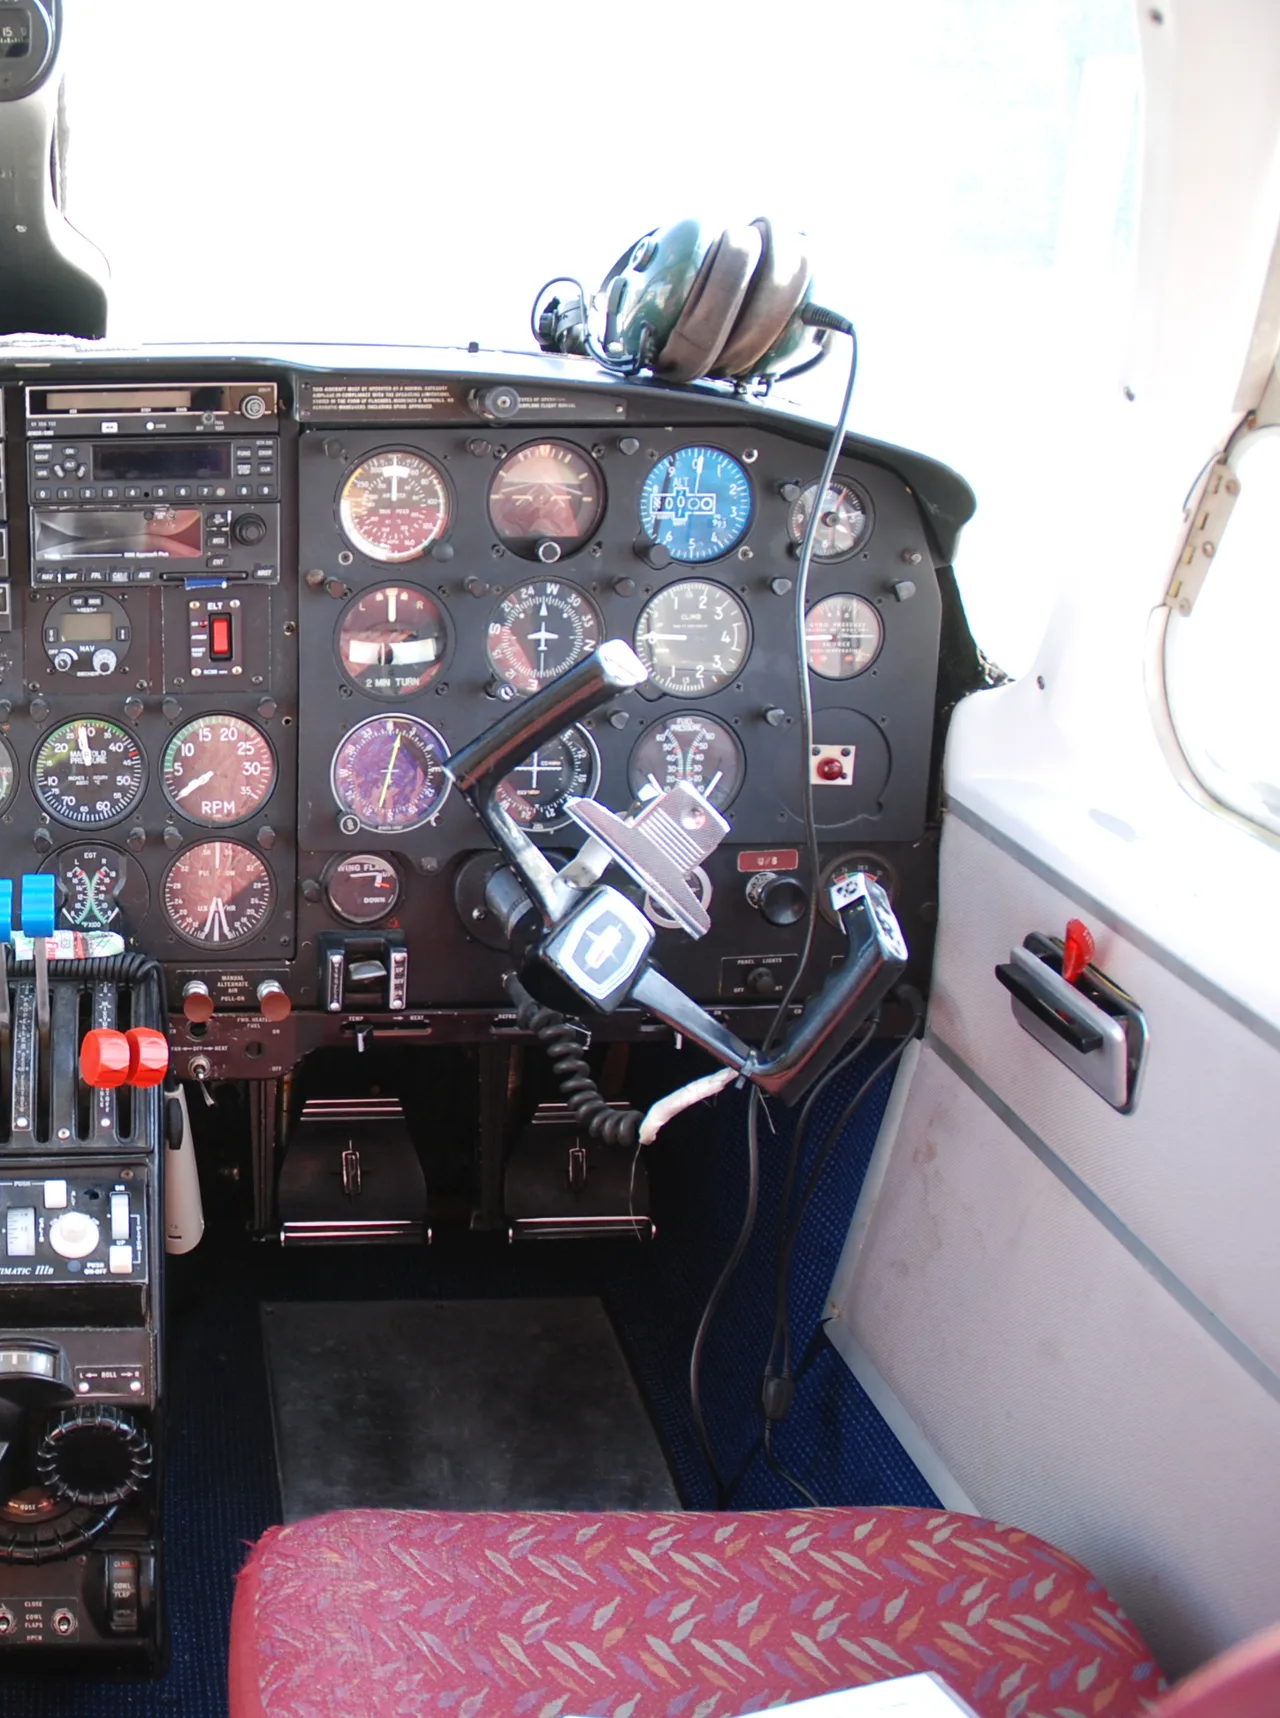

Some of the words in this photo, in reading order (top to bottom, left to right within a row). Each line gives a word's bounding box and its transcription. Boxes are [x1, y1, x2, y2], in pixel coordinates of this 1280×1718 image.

[2, 27, 12, 36] 15
[673, 478, 688, 487] ALT
[207, 602, 223, 610] ELT
[674, 598, 678, 609] 1
[700, 596, 707, 608] 2
[714, 607, 723, 619] 3
[722, 631, 730, 643] 4
[712, 658, 721, 668] 3
[671, 665, 675, 677] 1
[696, 665, 704, 677] 2
[366, 679, 373, 687] 2
[375, 679, 390, 687] MIN
[396, 678, 420, 686] TURN
[199, 728, 212, 741] 15
[220, 727, 238, 741] 20
[54, 743, 68, 752] 20
[109, 742, 123, 752] 40
[181, 744, 195, 757] 10
[237, 742, 254, 755] 25
[174, 764, 183, 775] 5
[242, 762, 260, 775] 30
[48, 776, 58, 786] 10
[116, 776, 131, 785] 50
[240, 786, 251, 795] 35
[62, 796, 75, 806] 70
[96, 801, 110, 811] 60
[202, 801, 235, 813] RPM
[757, 857, 778, 865] U/S
[337, 864, 360, 873] WING
